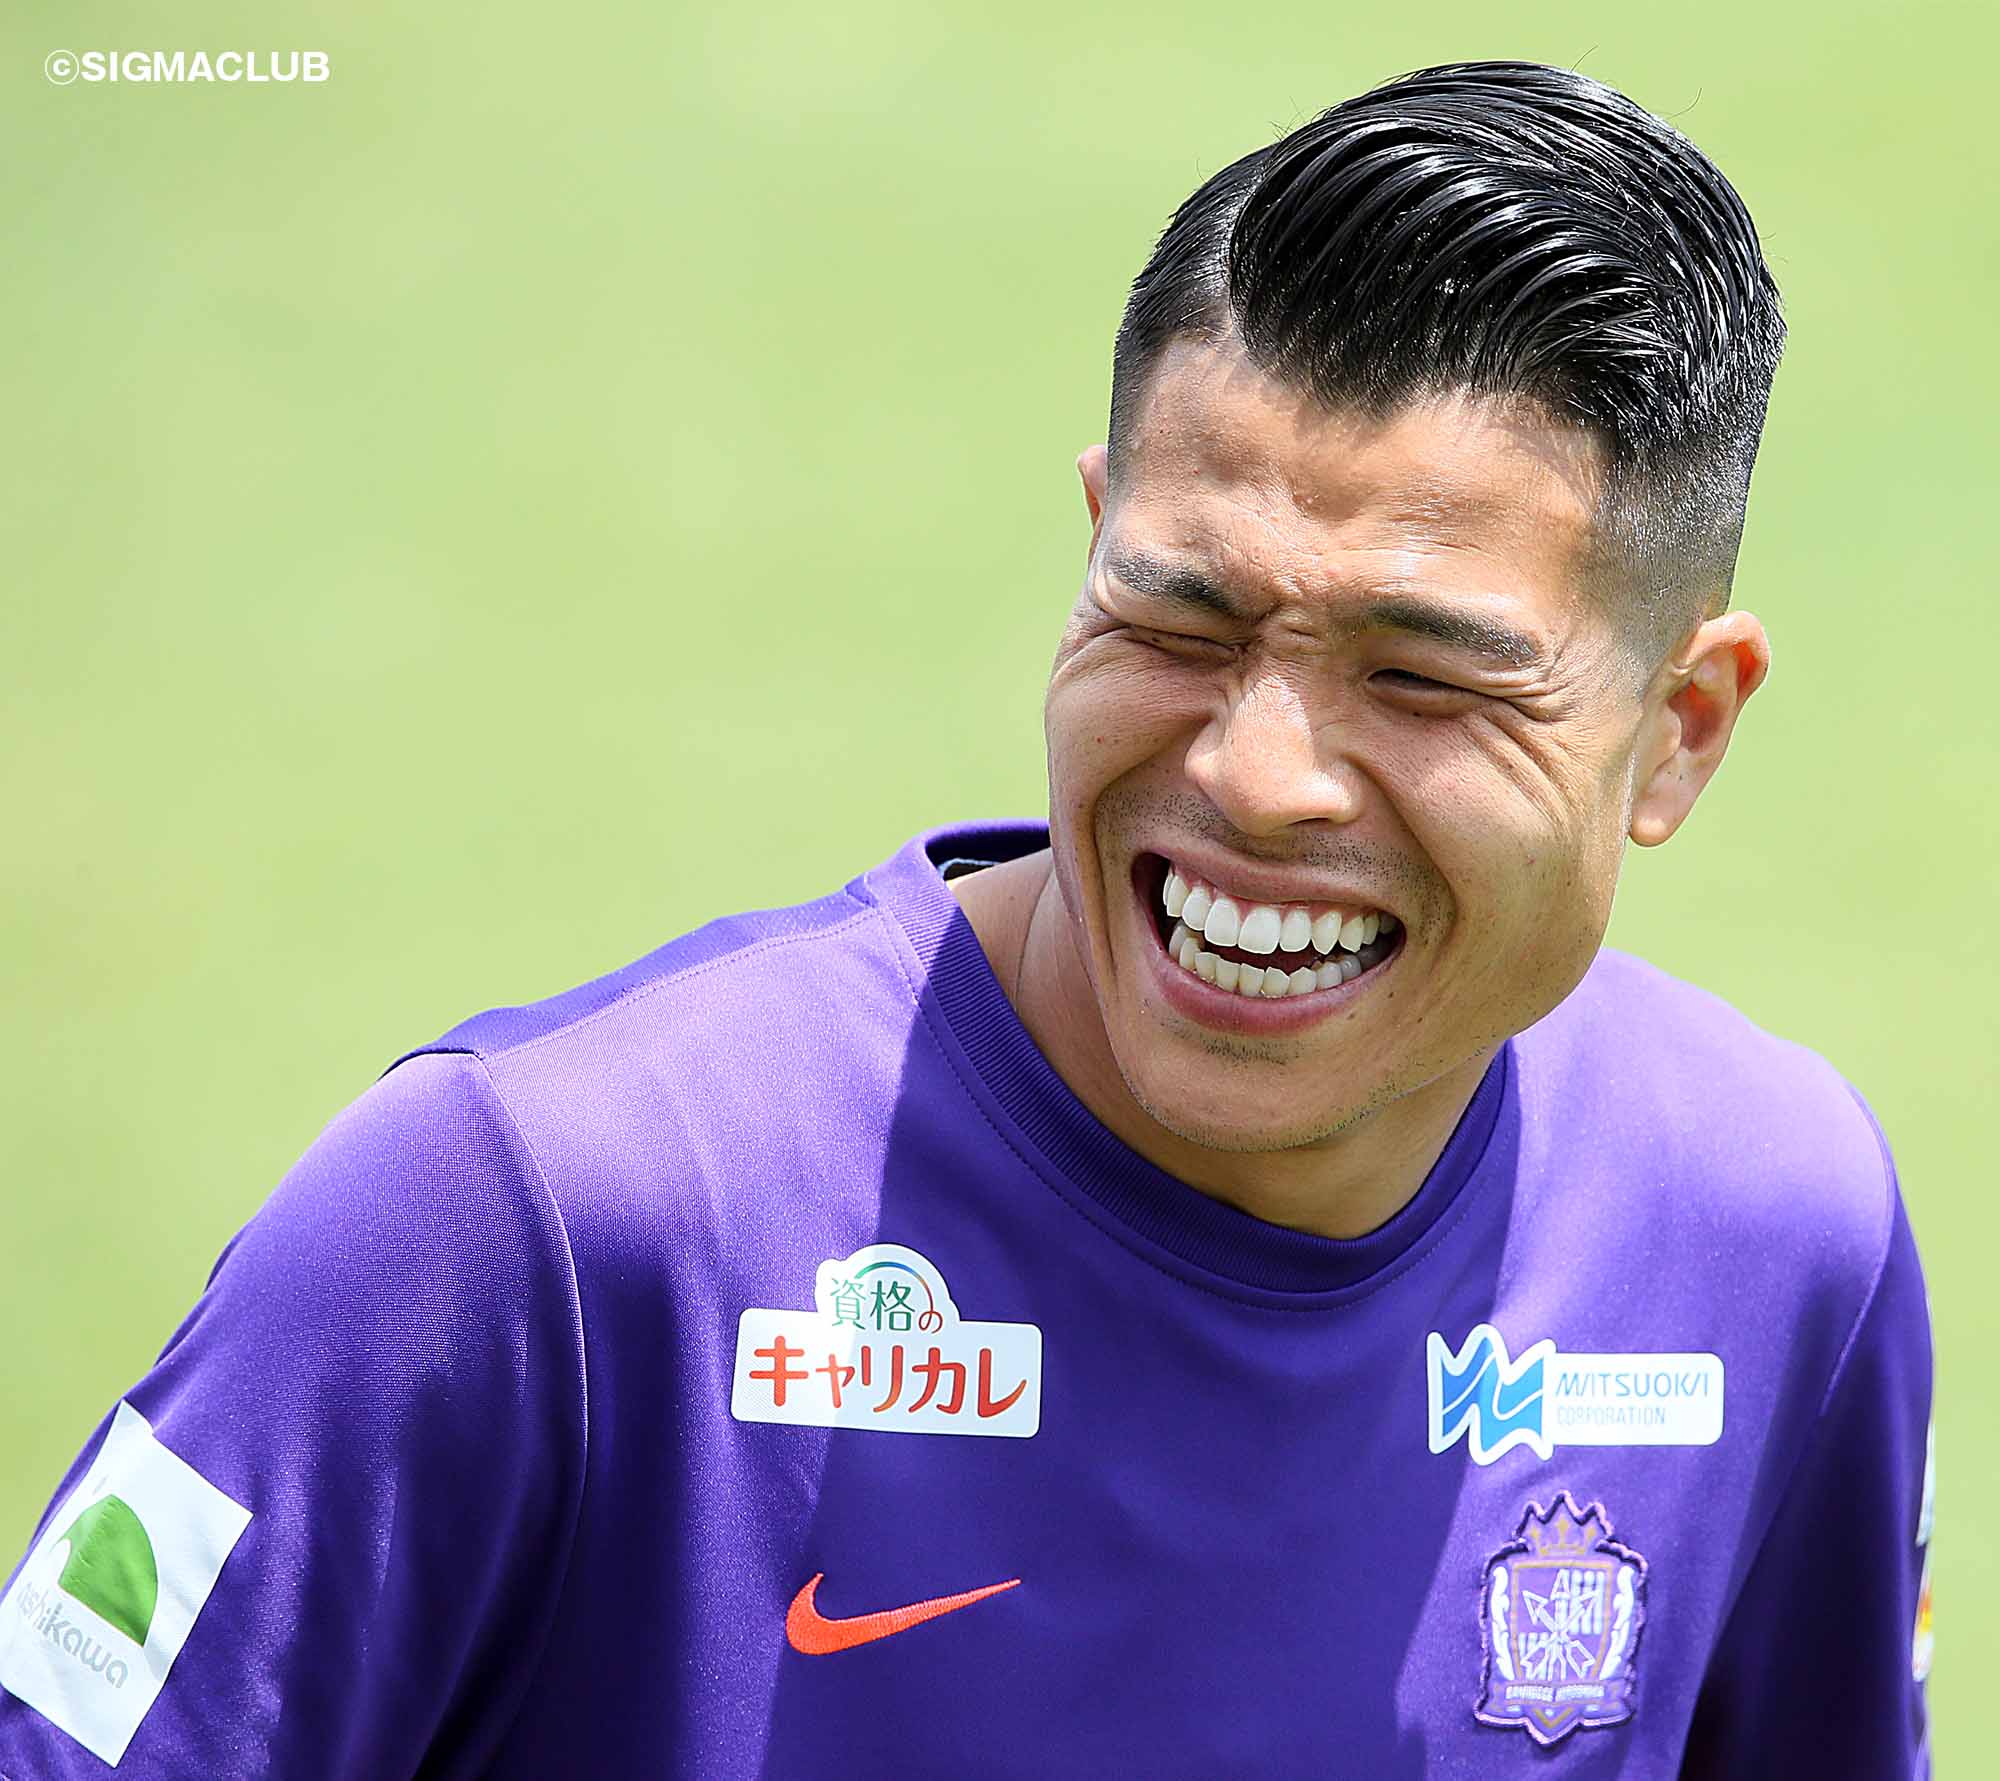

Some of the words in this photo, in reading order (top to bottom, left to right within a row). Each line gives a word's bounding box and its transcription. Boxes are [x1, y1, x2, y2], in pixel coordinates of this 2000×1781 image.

[829, 1277, 944, 1335] 資格の
[748, 1335, 1028, 1418] キャリカレ
[1556, 1405, 1667, 1427] CORPORATION
